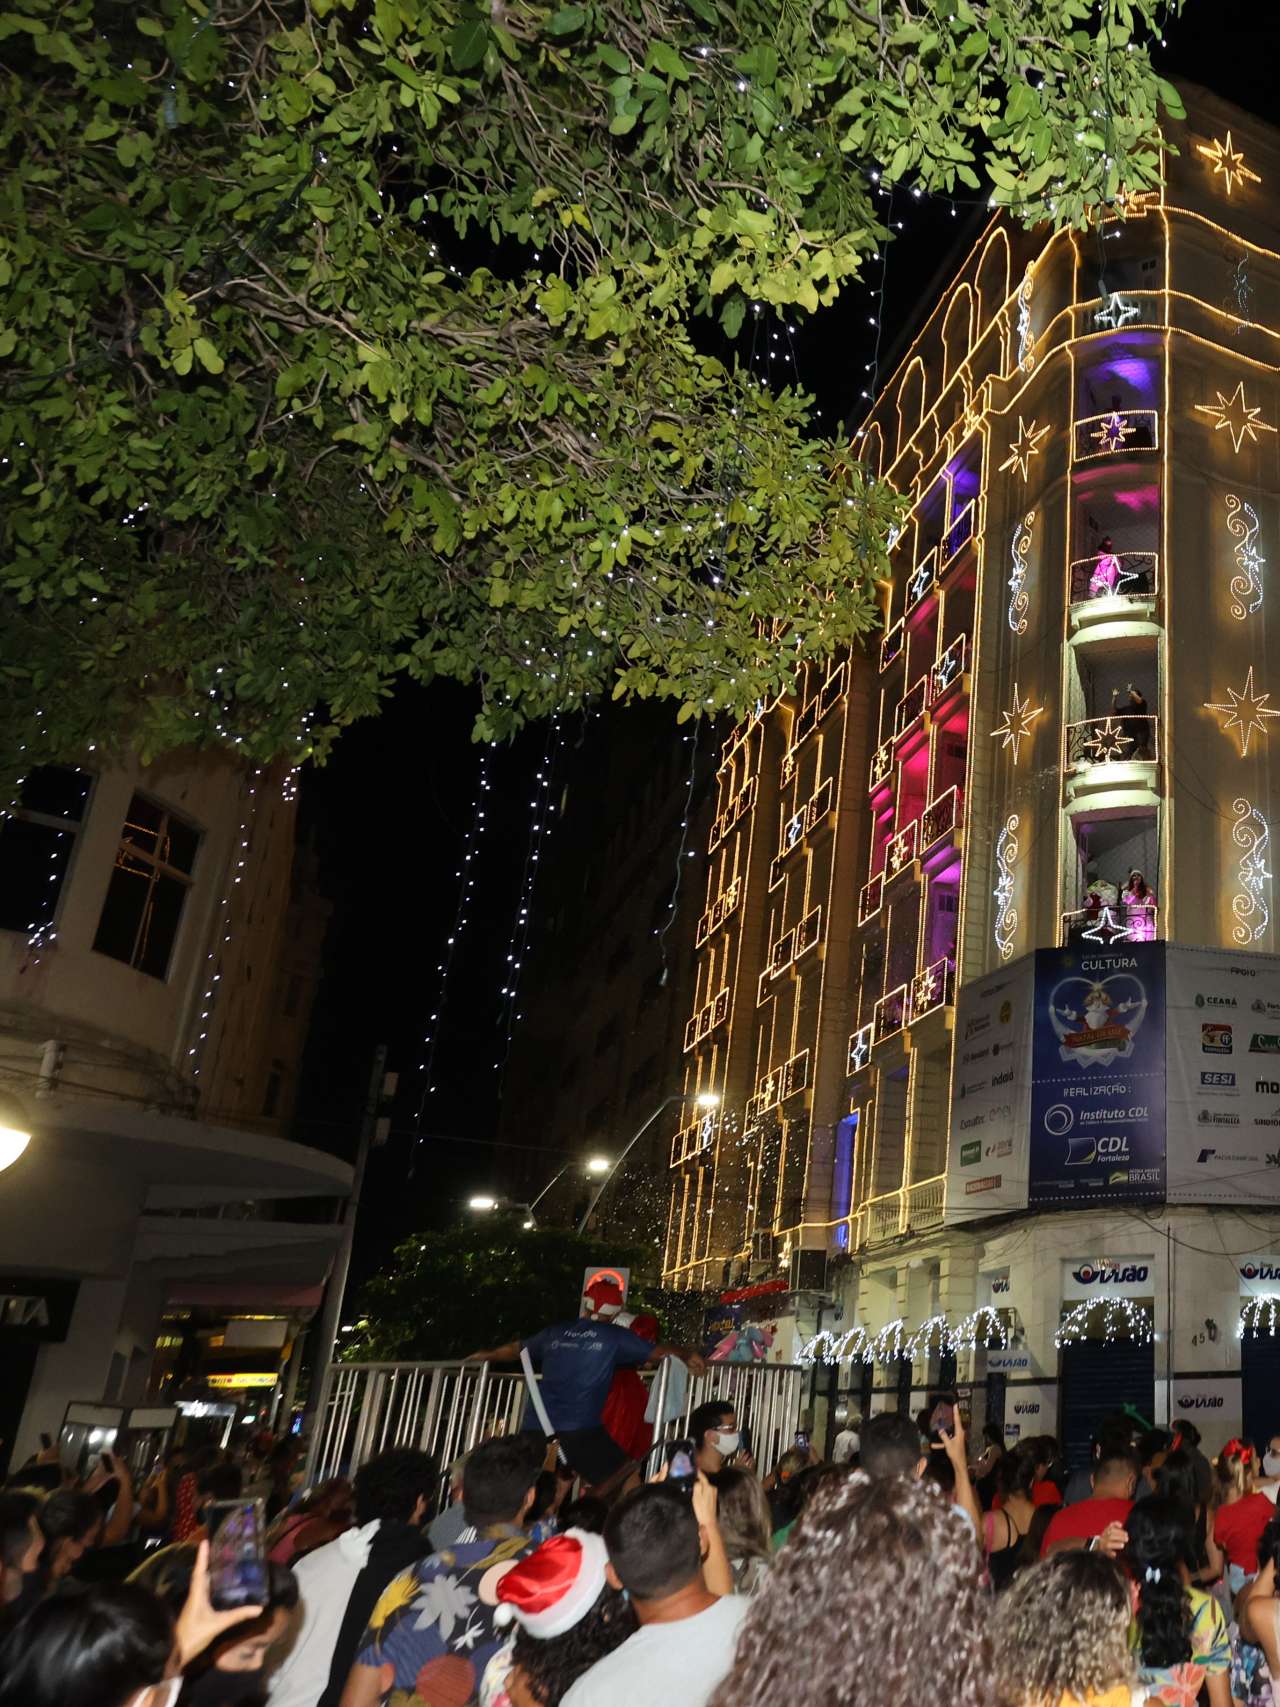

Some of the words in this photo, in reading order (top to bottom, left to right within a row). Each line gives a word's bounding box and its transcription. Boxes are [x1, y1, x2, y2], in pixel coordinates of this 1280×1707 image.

[1081, 957, 1138, 971] CULTURA
[1202, 1073, 1233, 1085] SESI
[1080, 1109, 1126, 1121] Instituto
[1128, 1106, 1149, 1118] CDL
[1097, 1136, 1130, 1153] CDL
[1097, 1154, 1130, 1163] Fortaleza
[1129, 1172, 1160, 1182] BRASIL
